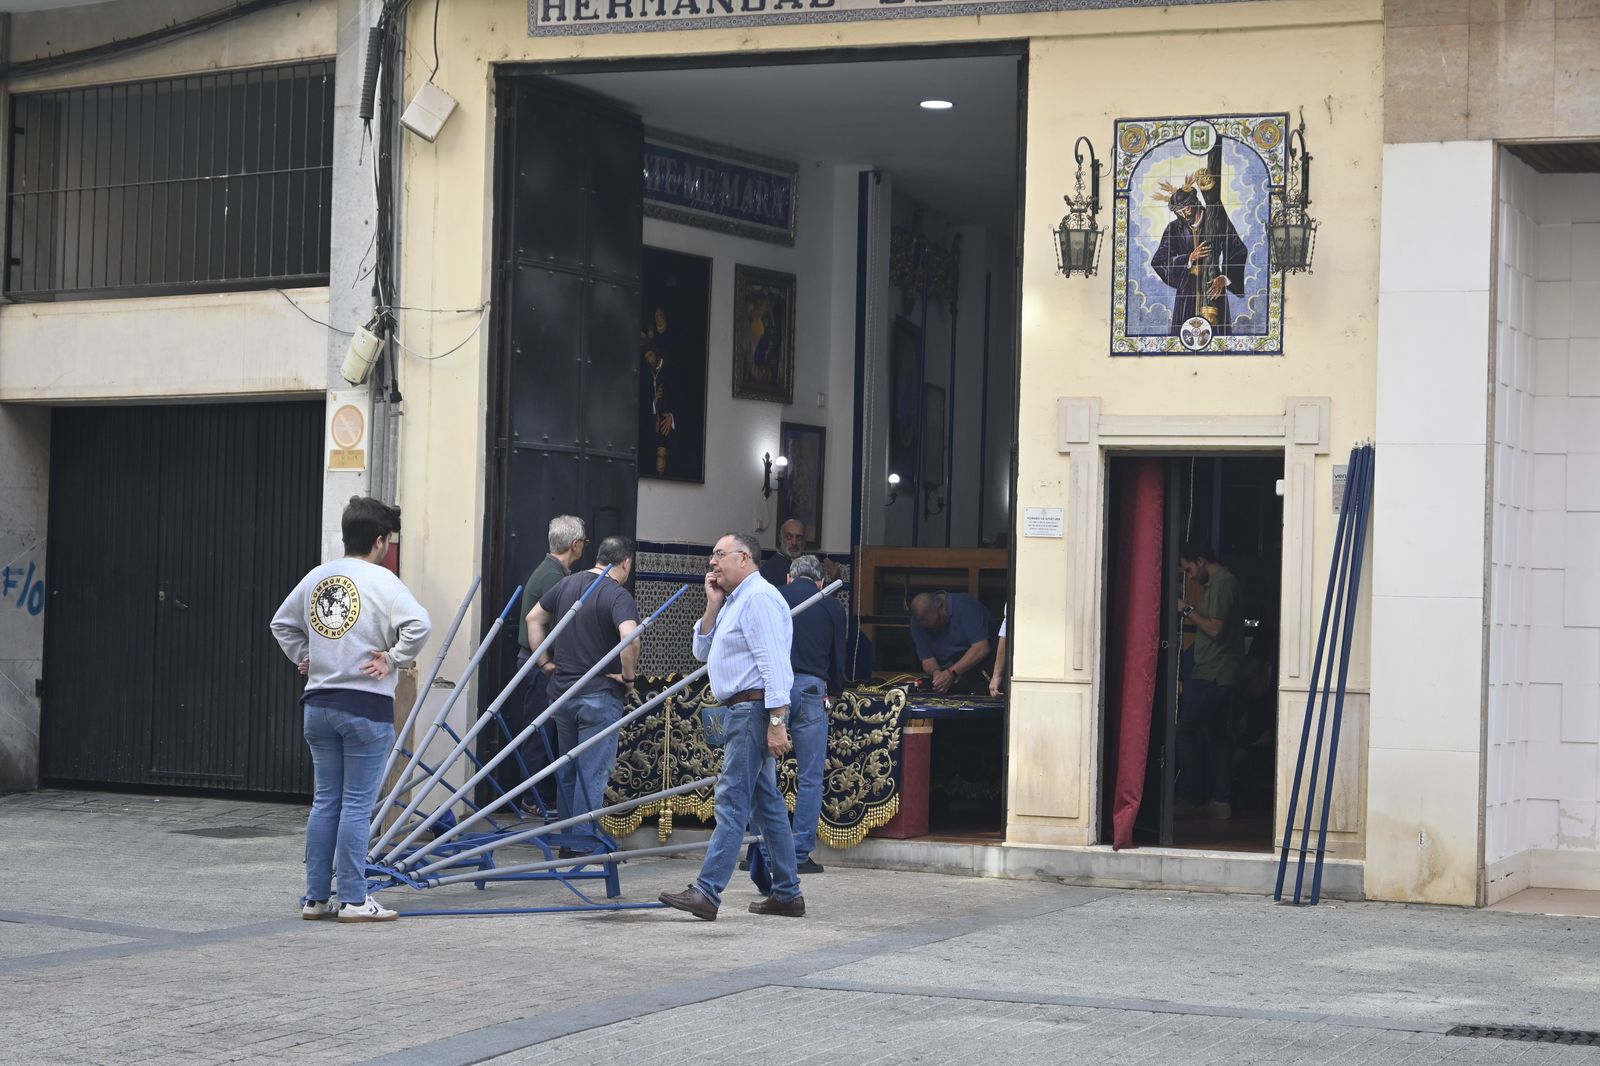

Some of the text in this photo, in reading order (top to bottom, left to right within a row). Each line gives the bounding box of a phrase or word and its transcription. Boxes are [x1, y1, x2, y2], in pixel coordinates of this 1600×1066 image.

[541, 0, 835, 22] HERMAN
[311, 577, 341, 605] COMMON
[342, 580, 358, 603] NOISE
[310, 612, 329, 636] VOICE
